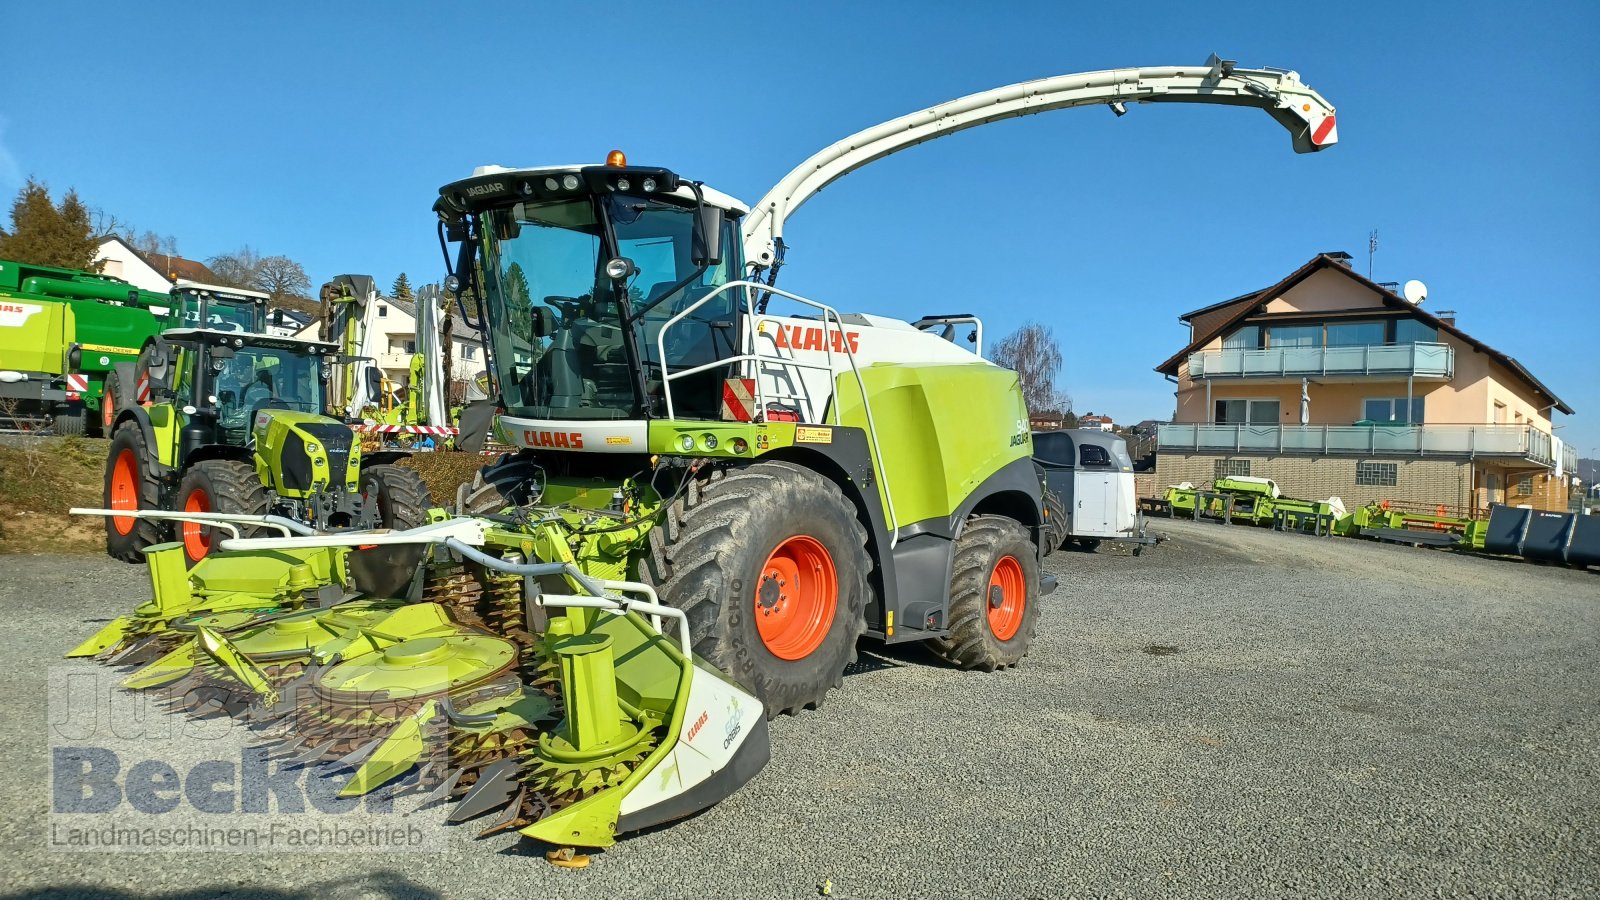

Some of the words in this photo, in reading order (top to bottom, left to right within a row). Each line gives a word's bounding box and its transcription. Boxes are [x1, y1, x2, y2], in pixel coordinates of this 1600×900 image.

[466, 182, 505, 197] JAGUAR
[254, 341, 298, 349] ARION
[775, 324, 860, 354] CLAAS
[95, 345, 112, 353] JOHN
[523, 430, 584, 449] CLAAS
[1009, 432, 1029, 447] JAGUAR
[728, 578, 743, 628] CHO
[687, 710, 709, 742] CLAAS
[723, 722, 741, 750] ORBIS
